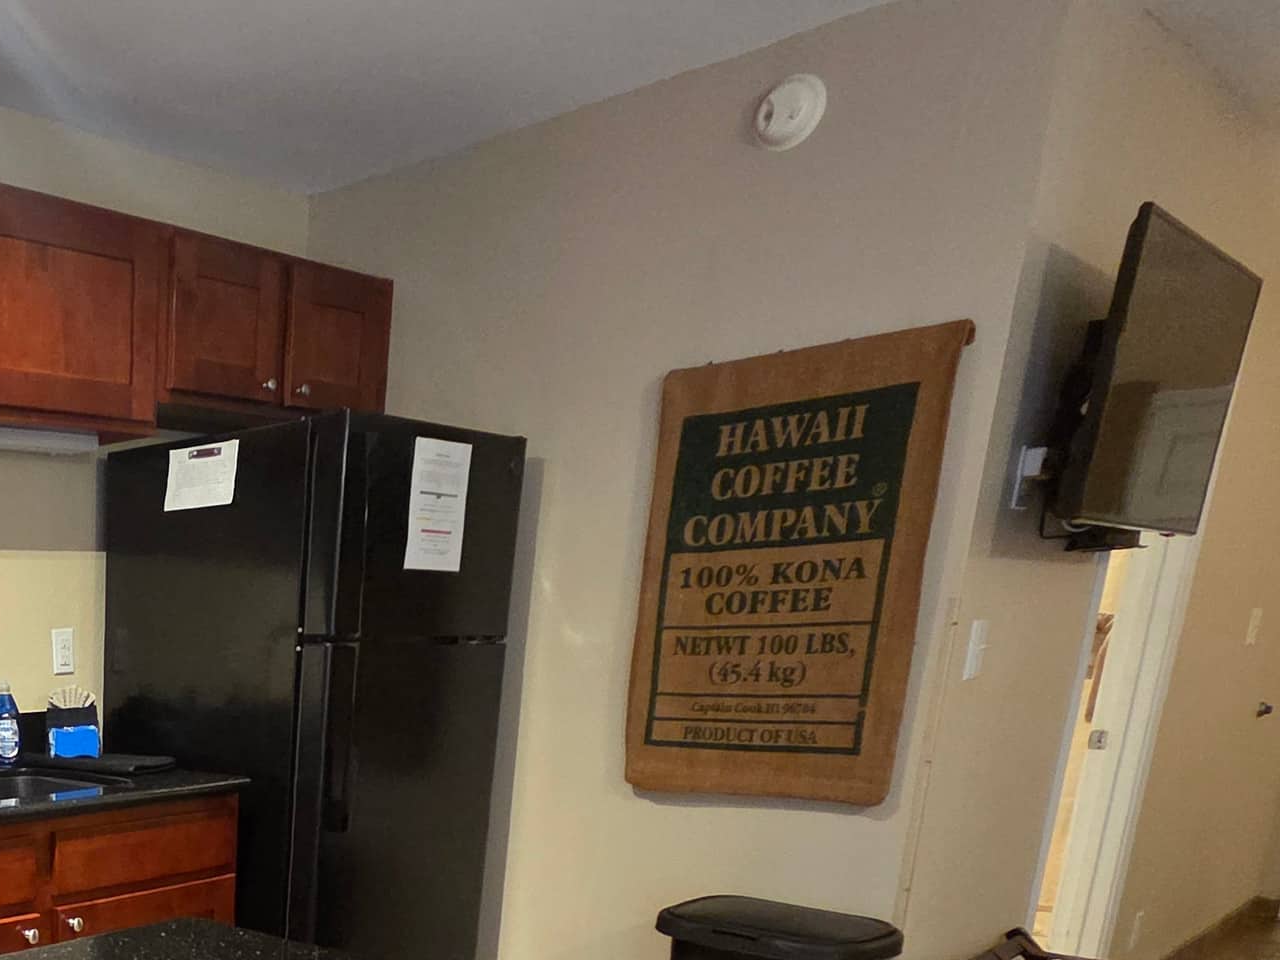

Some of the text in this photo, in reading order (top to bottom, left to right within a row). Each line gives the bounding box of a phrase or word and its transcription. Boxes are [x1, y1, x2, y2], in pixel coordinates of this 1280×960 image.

[716, 403, 870, 457] HAWAII
[711, 454, 860, 501] COFFEE
[683, 499, 883, 548] COMPANY
[680, 557, 868, 589] 100% KONA
[705, 587, 833, 615] COFFEE
[757, 634, 798, 655] 100
[708, 660, 807, 687] (45.4 kg)
[682, 726, 818, 745] PRODUCT OF USA
